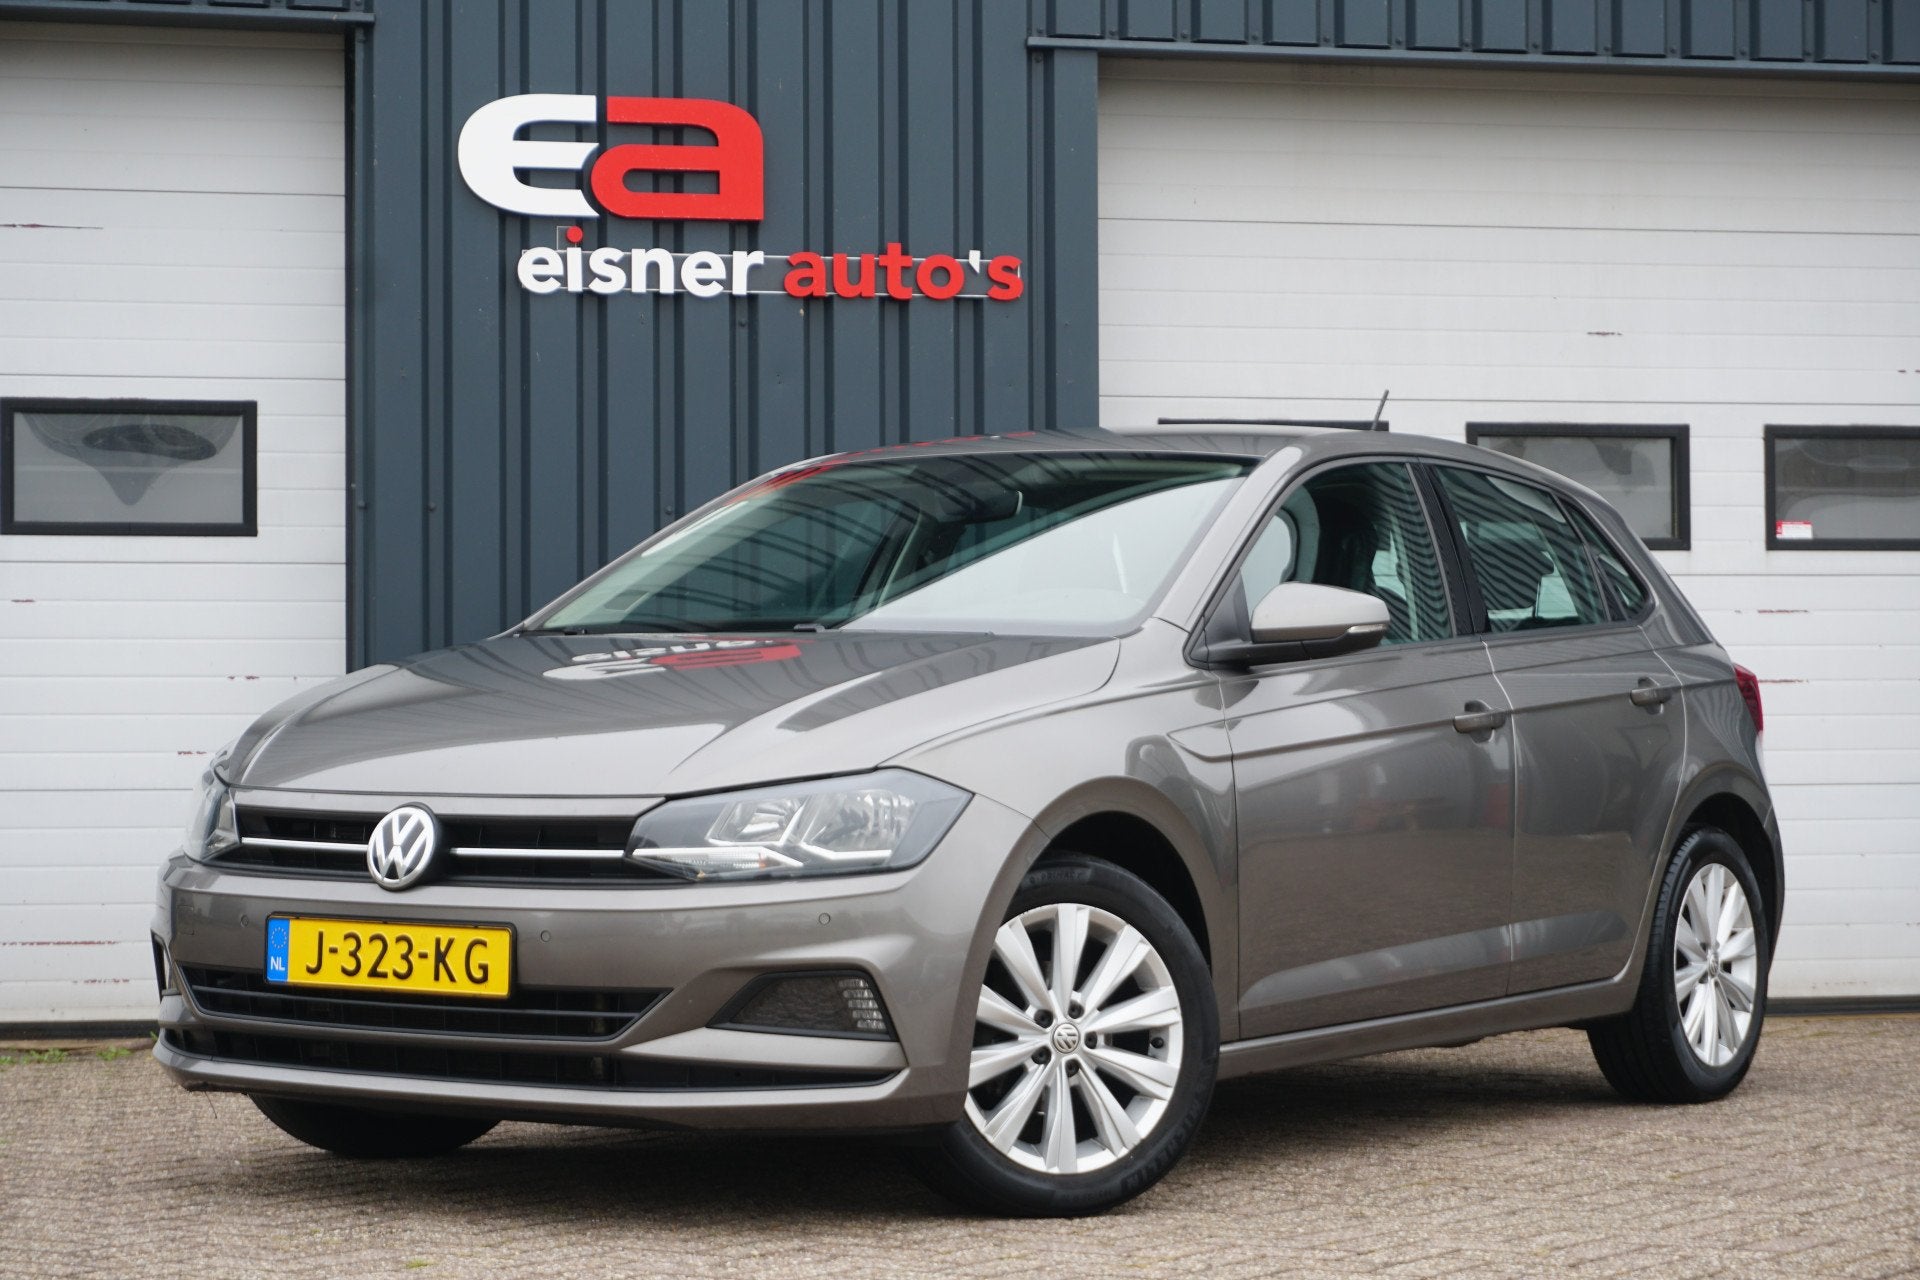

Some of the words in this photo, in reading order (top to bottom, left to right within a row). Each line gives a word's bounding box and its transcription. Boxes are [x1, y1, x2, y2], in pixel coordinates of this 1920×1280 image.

[458, 93, 764, 221] ea
[517, 226, 764, 297] eisner
[783, 242, 1024, 300] auto's
[368, 807, 435, 886] VW
[270, 955, 286, 971] NL
[305, 930, 490, 985] J-323-KG
